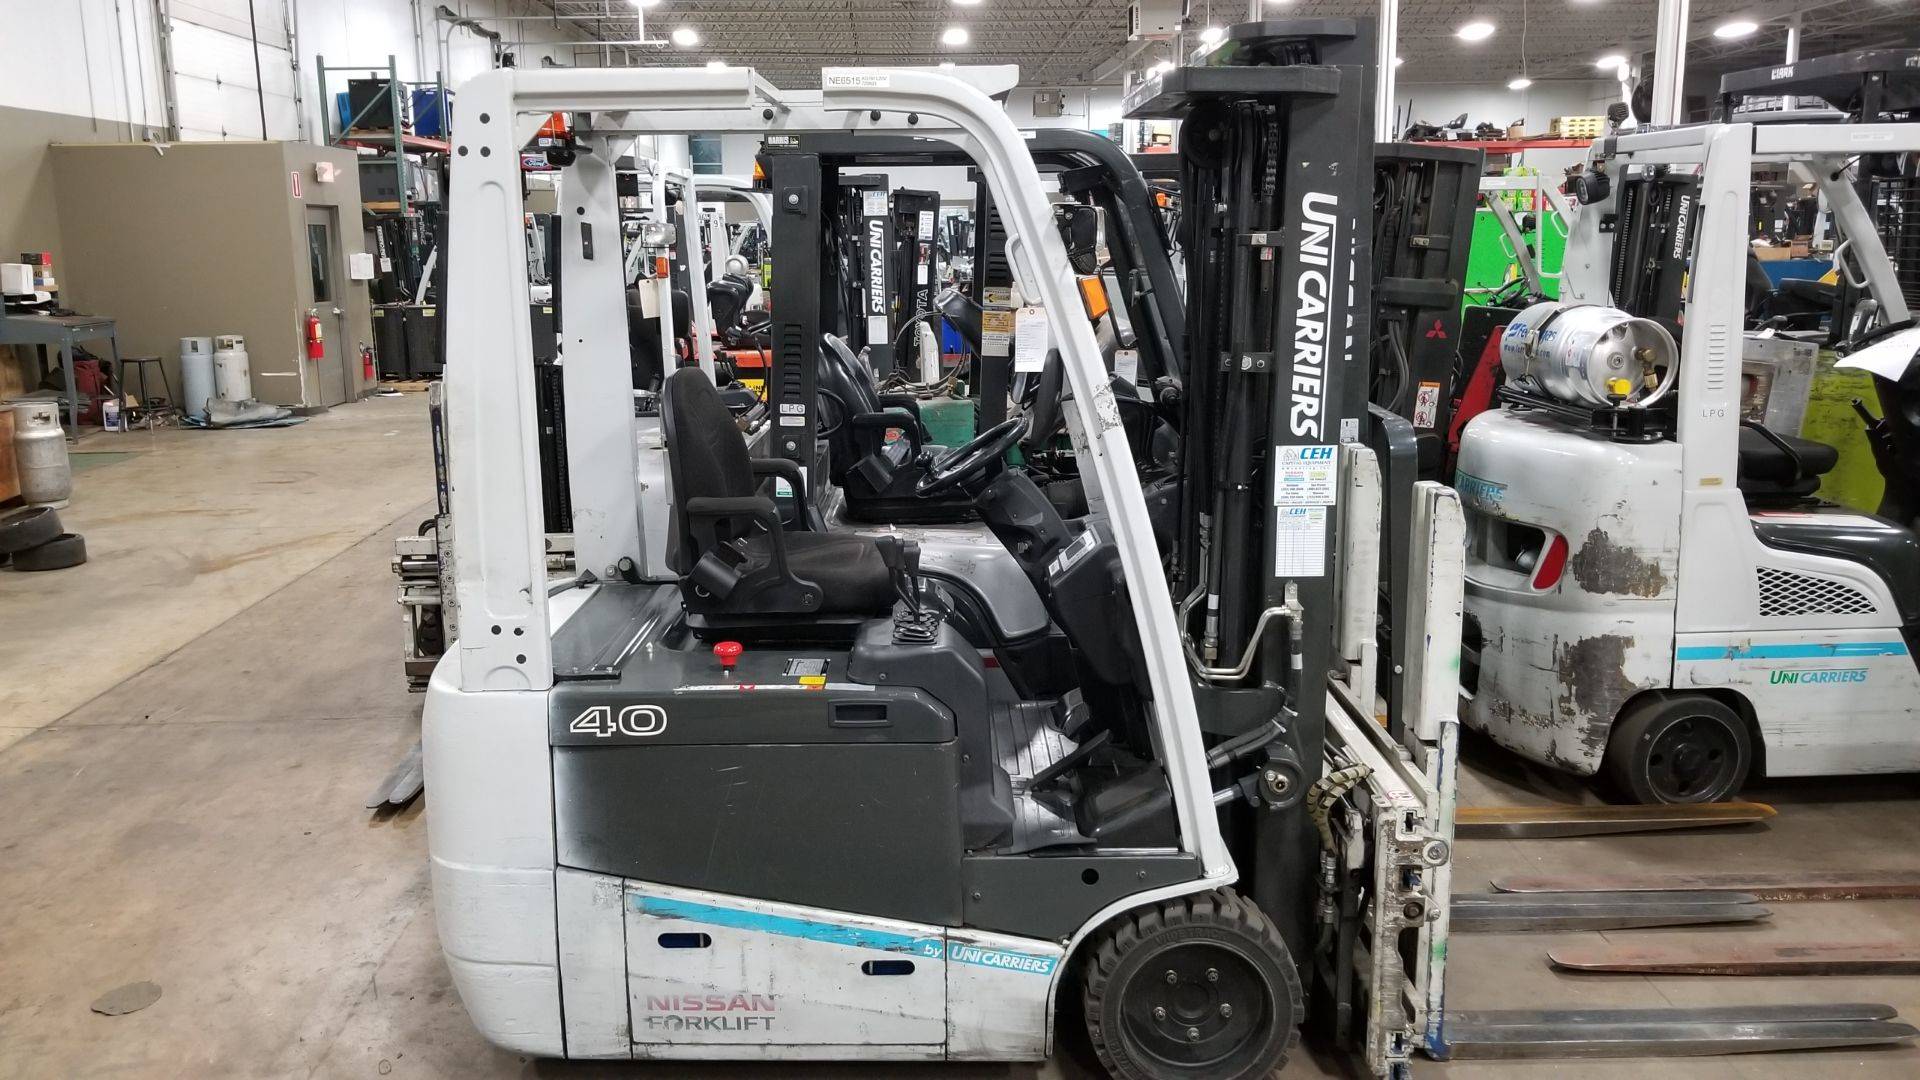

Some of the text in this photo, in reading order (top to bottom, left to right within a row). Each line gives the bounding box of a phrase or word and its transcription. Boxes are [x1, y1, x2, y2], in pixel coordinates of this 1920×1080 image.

[1673, 194, 1691, 260] UNICARRIERS
[869, 220, 886, 314] UNICARRIERS
[1290, 191, 1338, 443] UNICARRIERS
[781, 405, 804, 413] LPG
[1702, 409, 1725, 418] LPG
[1300, 447, 1333, 460] CEH
[570, 704, 668, 737] 40
[923, 944, 942, 959] by
[646, 994, 776, 1012] NISSAN
[644, 1014, 776, 1032] FORKLIFT
